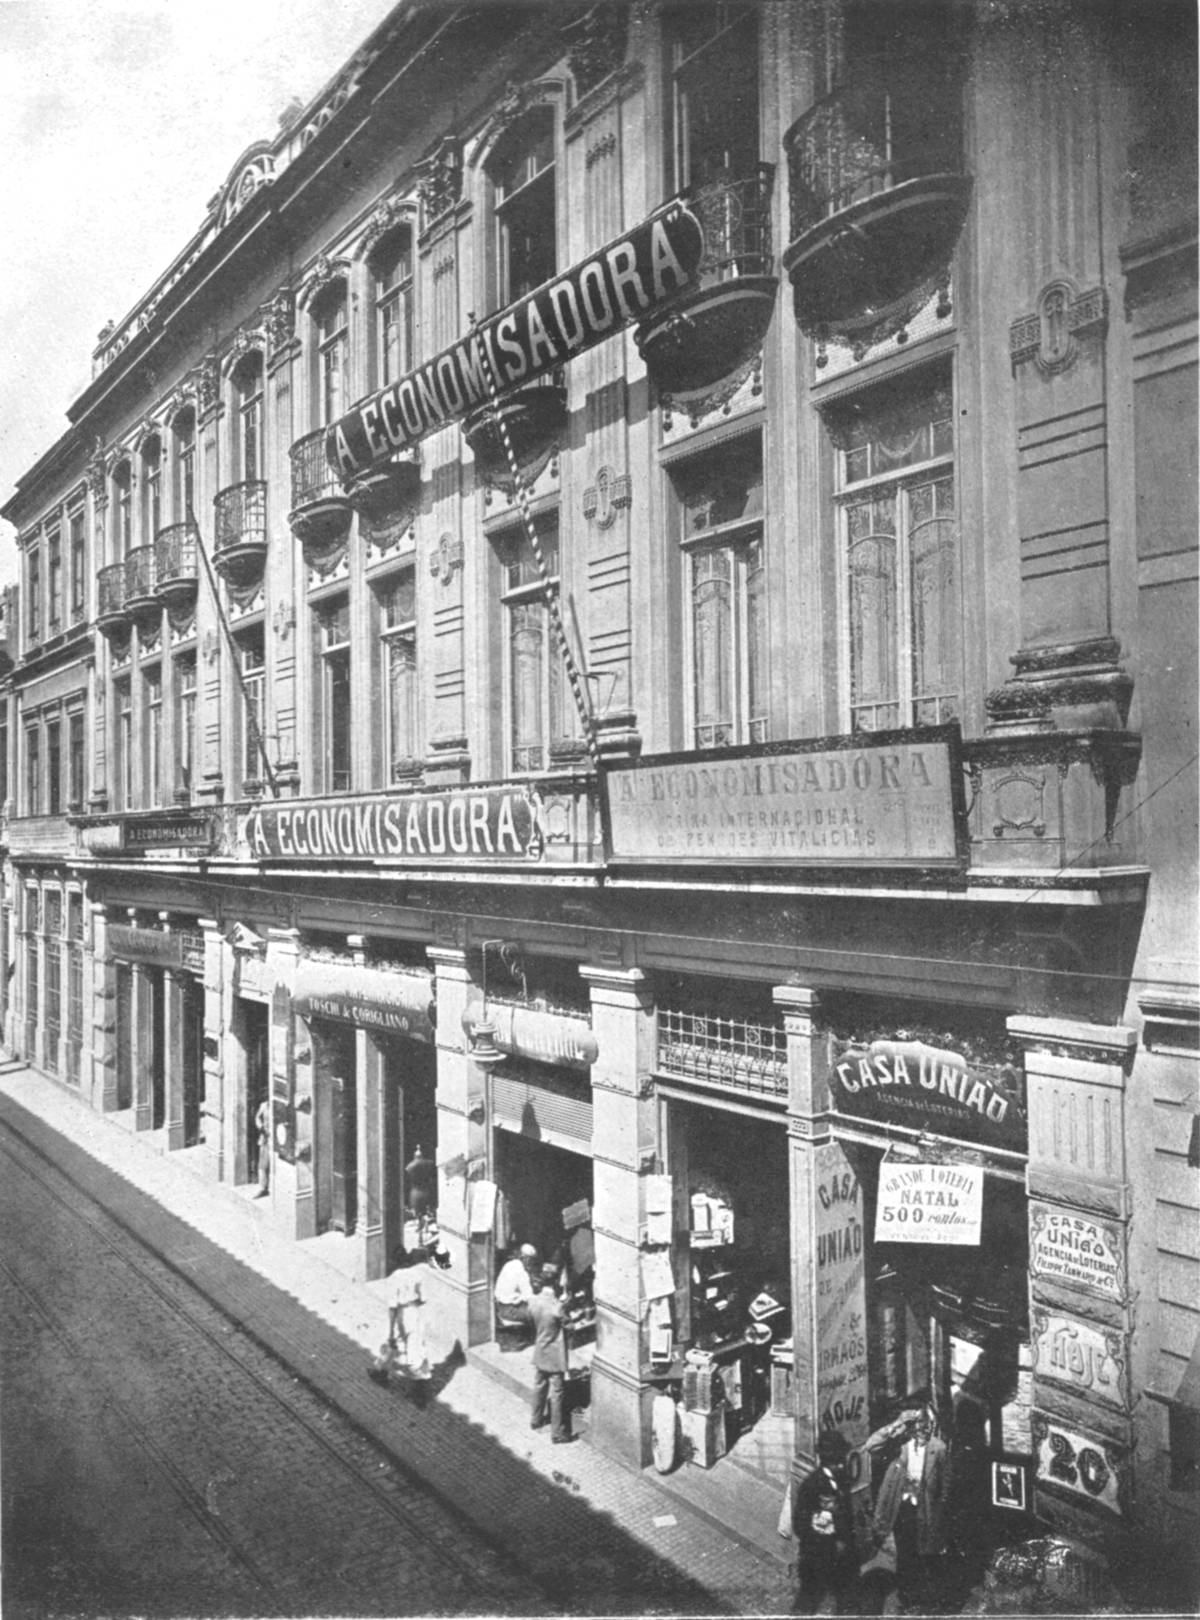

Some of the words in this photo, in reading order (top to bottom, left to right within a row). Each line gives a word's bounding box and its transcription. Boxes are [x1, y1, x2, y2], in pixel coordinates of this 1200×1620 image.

[651, 752, 932, 801] ECONOMISADORA
[836, 1054, 912, 1093] CASA
[818, 1172, 859, 1210] CASA
[900, 1189, 959, 1208] NATAL
[882, 1205, 924, 1224] 500
[1050, 1215, 1098, 1239] CASA
[1048, 1432, 1111, 1497] 20
